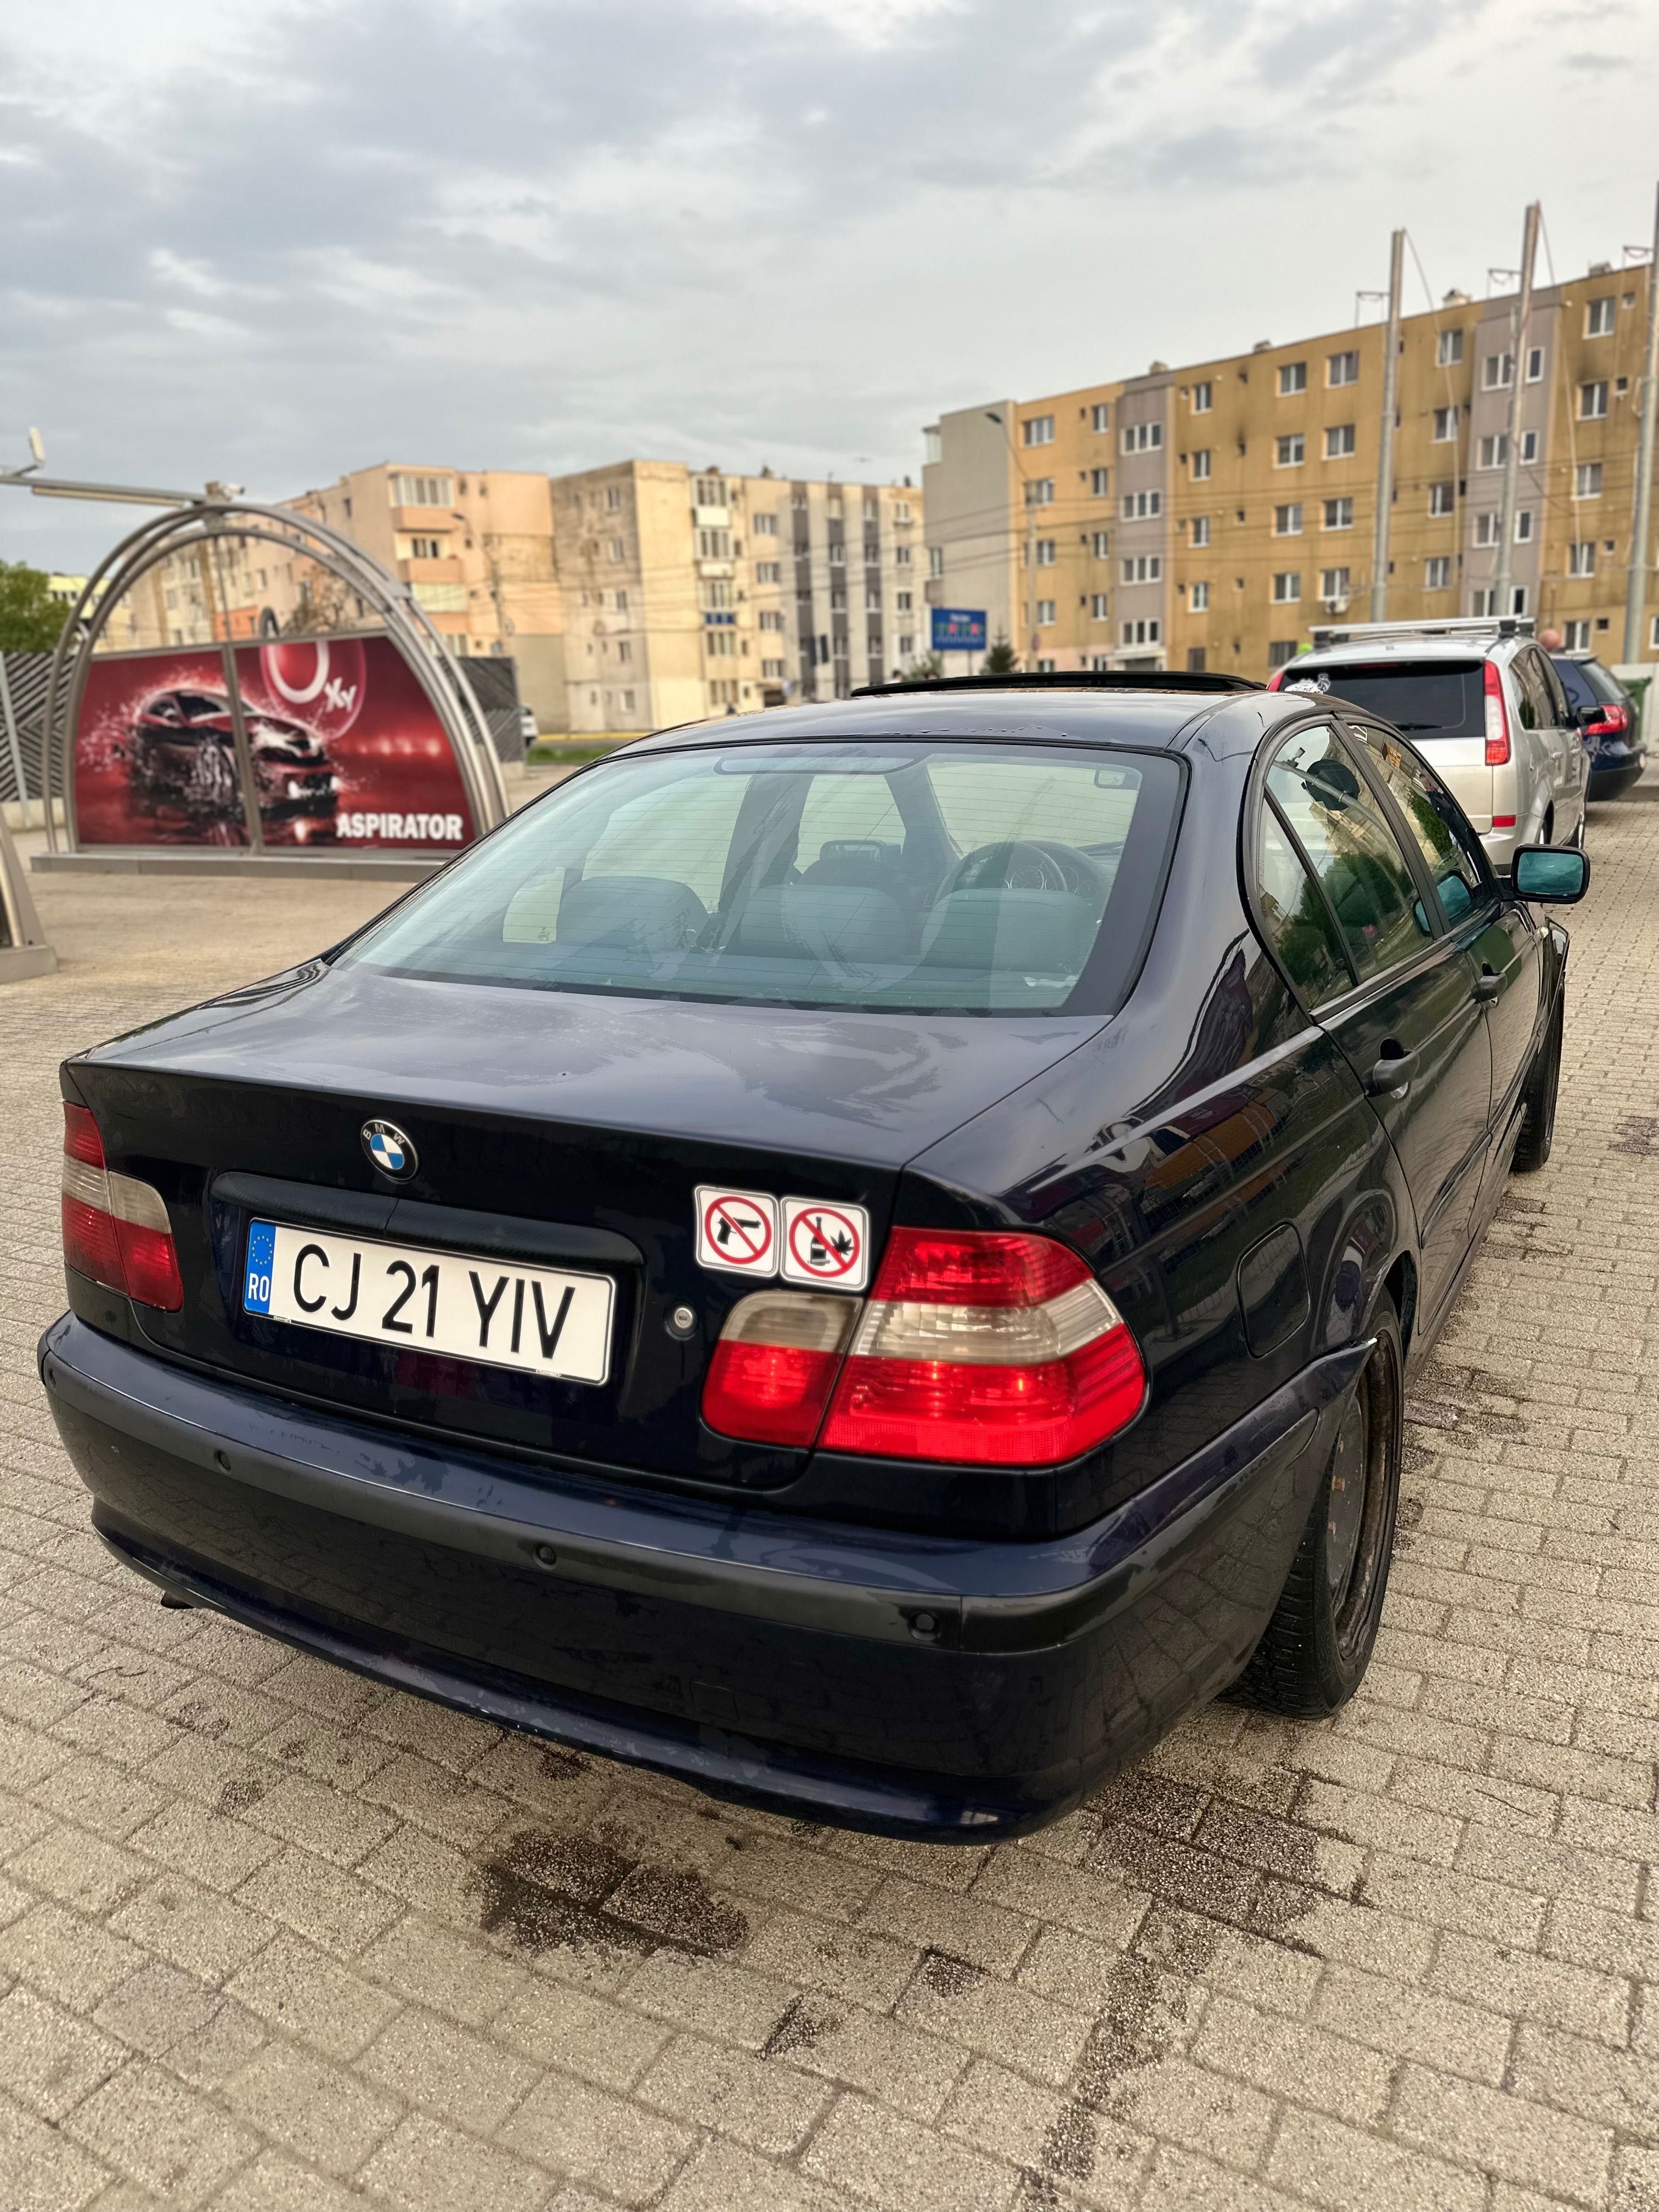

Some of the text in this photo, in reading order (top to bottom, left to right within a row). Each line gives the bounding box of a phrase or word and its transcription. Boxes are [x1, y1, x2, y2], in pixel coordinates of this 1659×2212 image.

[336, 812, 463, 840] ASPIRATOR
[363, 1123, 405, 1145] BMW
[248, 1273, 269, 1302] RO
[294, 1244, 575, 1359] CJ 21 YIV
